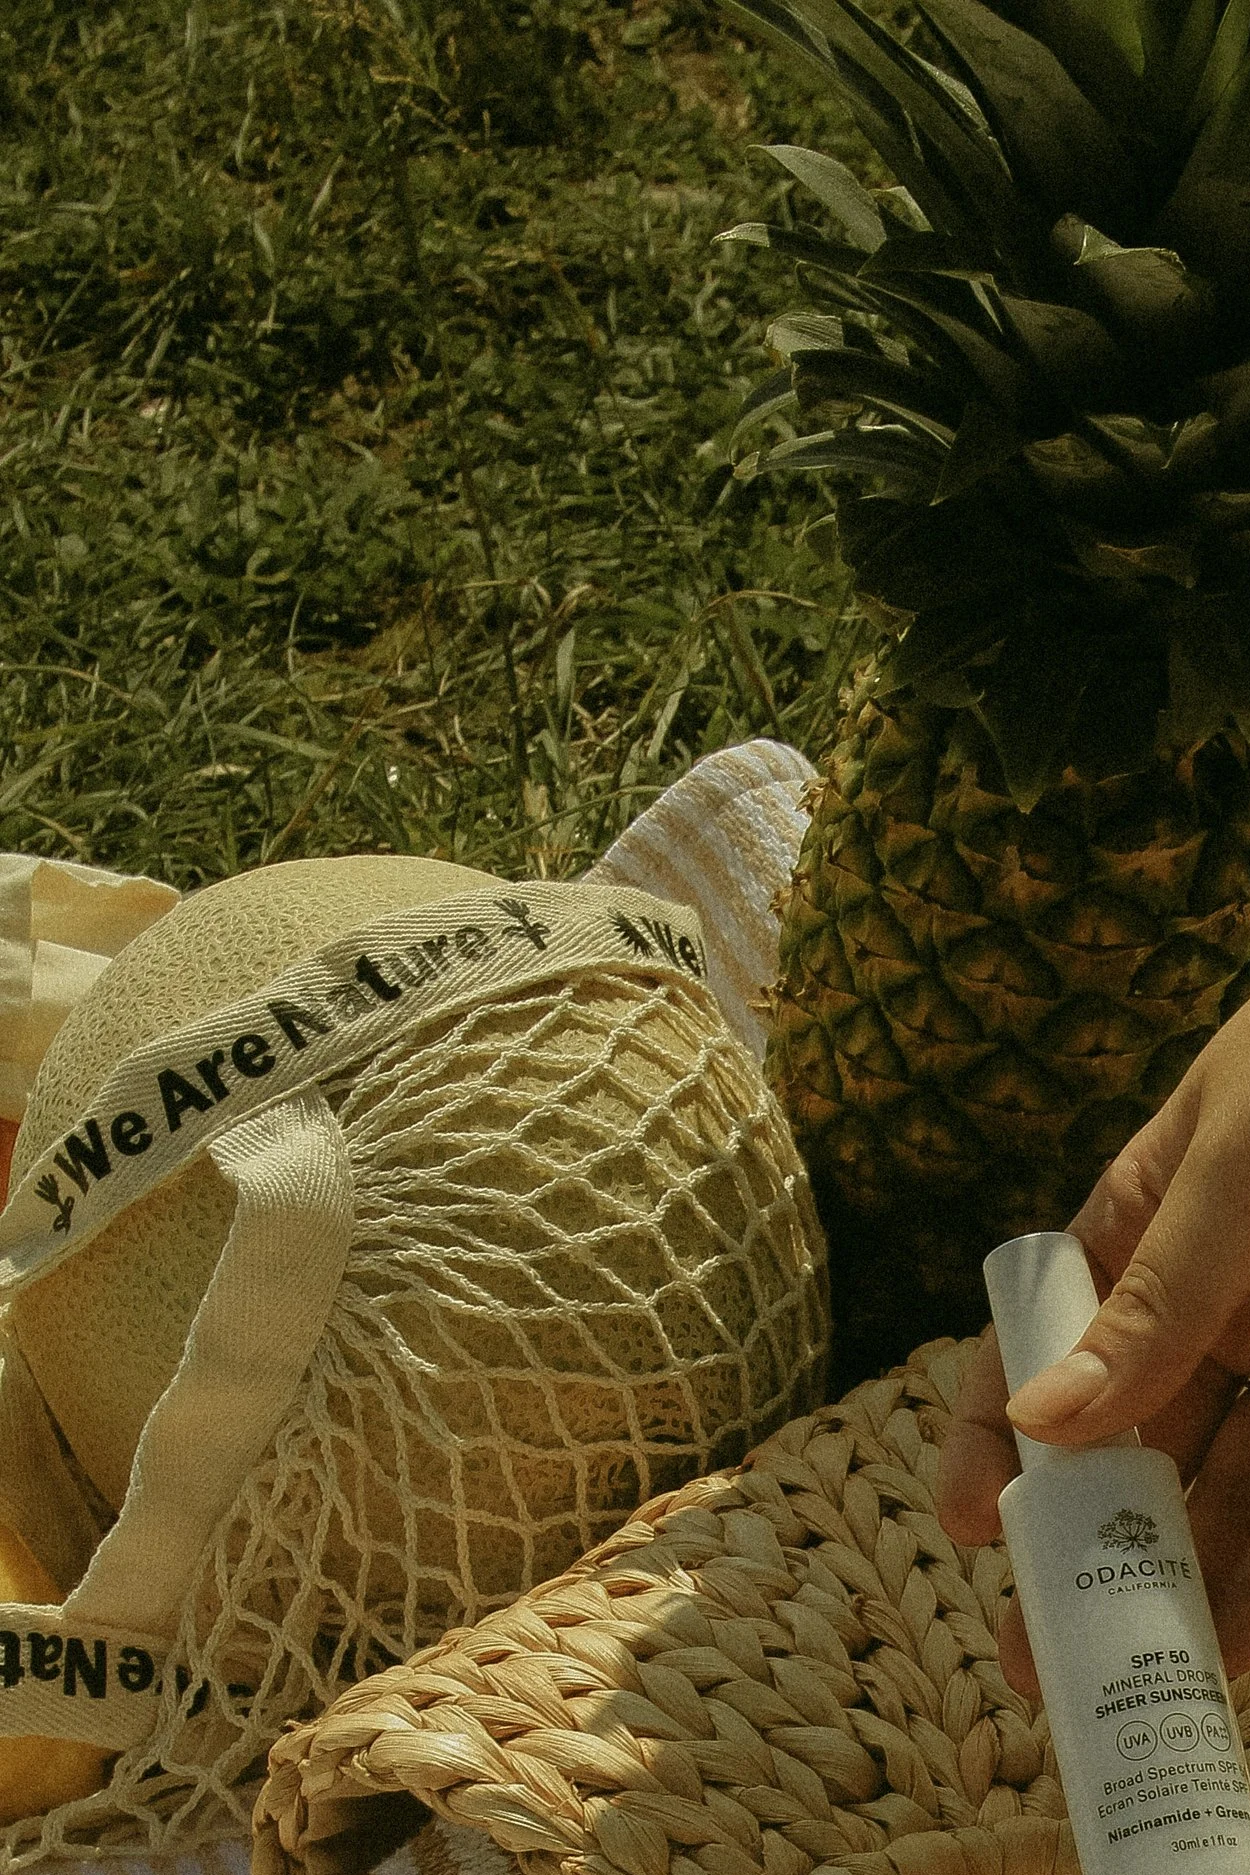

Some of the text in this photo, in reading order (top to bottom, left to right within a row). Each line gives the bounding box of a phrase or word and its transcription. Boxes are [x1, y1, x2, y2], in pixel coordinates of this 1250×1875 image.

[639, 915, 701, 978] We
[53, 926, 495, 1196] We Are Nature
[1075, 1557, 1192, 1590] ODACITÉ
[1108, 1581, 1178, 1595] CALIFORNIA
[1131, 1650, 1190, 1669] SPF 50
[1102, 1669, 1218, 1697] MINERAL DROPS
[1095, 1694, 1147, 1719] SHEER
[1123, 1732, 1151, 1750] UVA
[1166, 1725, 1194, 1740] UVB
[1103, 1771, 1144, 1796] Broad
[1148, 1761, 1216, 1782] Spectrum
[1218, 1760, 1239, 1776] SPF
[1137, 1783, 1189, 1803] Solaire
[1191, 1779, 1230, 1793] Teinté
[1107, 1806, 1201, 1844] Niacinamide
[1215, 1805, 1250, 1821] Green
[1171, 1837, 1200, 1852] 30ml
[1227, 1837, 1238, 1847] oz
